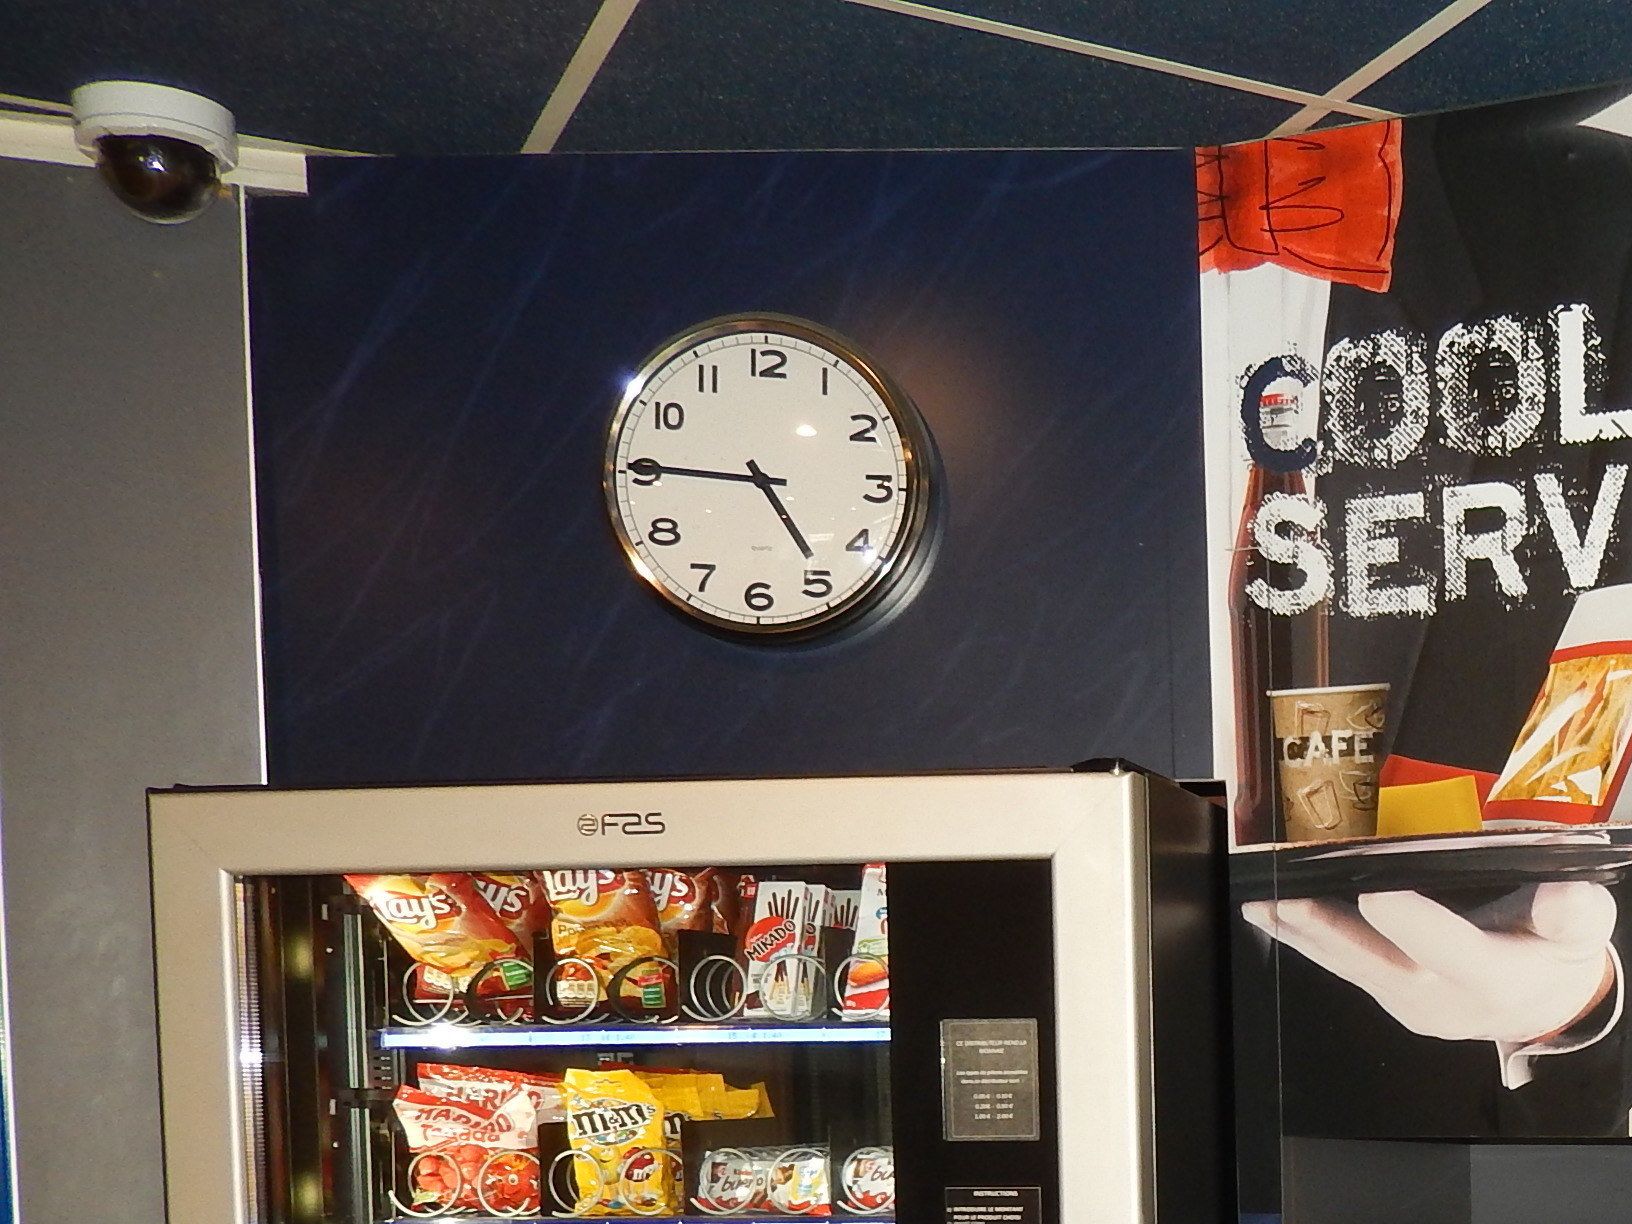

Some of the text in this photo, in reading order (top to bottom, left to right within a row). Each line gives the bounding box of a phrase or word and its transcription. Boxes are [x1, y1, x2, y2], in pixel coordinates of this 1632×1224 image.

[751, 348, 788, 379] 12
[698, 364, 718, 393] 11
[654, 401, 685, 430] 10
[849, 414, 878, 442] 2
[862, 474, 894, 503] 3
[648, 517, 681, 546] 8
[845, 528, 873, 552] 4
[689, 563, 717, 593] 7
[802, 570, 833, 598] 5
[744, 582, 774, 612] 6
[744, 919, 797, 962] MIKADO
